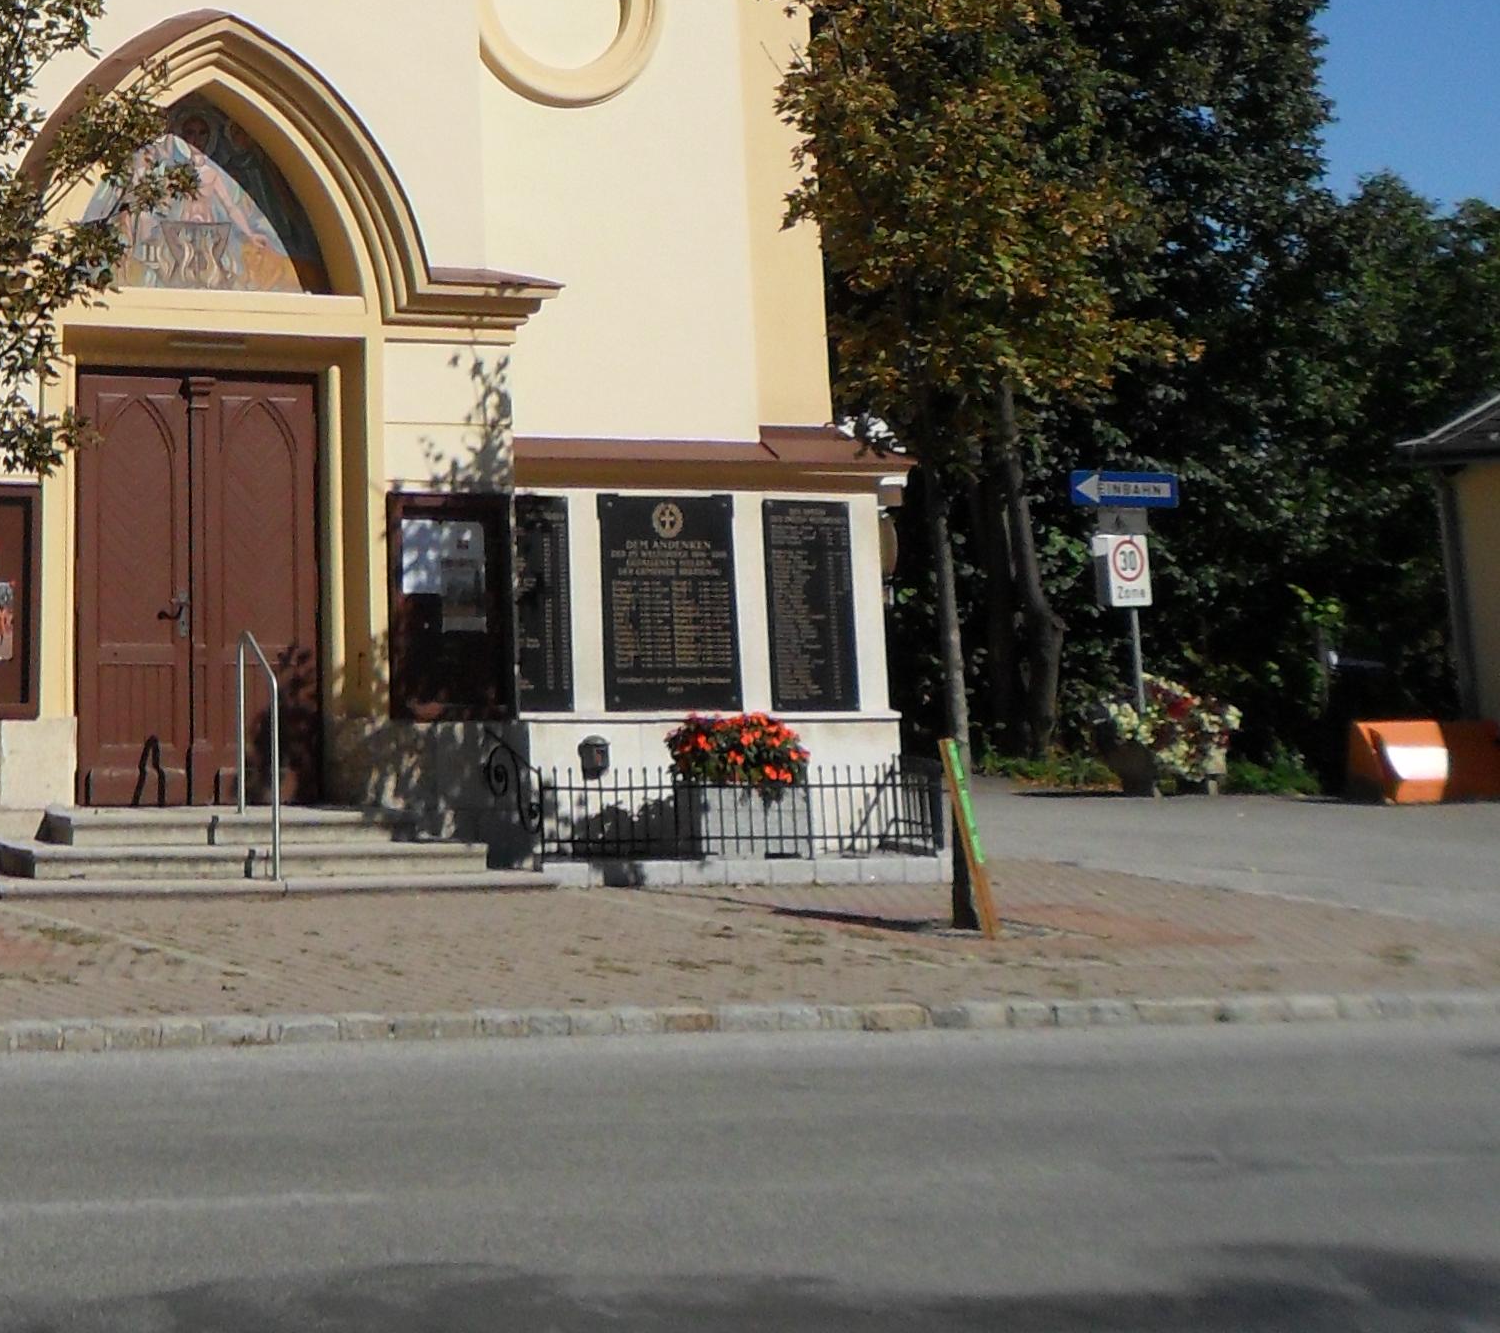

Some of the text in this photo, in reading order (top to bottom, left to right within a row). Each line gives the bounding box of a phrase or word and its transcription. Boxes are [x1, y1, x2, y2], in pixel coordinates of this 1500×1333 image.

[1097, 483, 1162, 496] EINBAHN
[1119, 550, 1138, 571] 30
[1117, 586, 1146, 599] Zone
